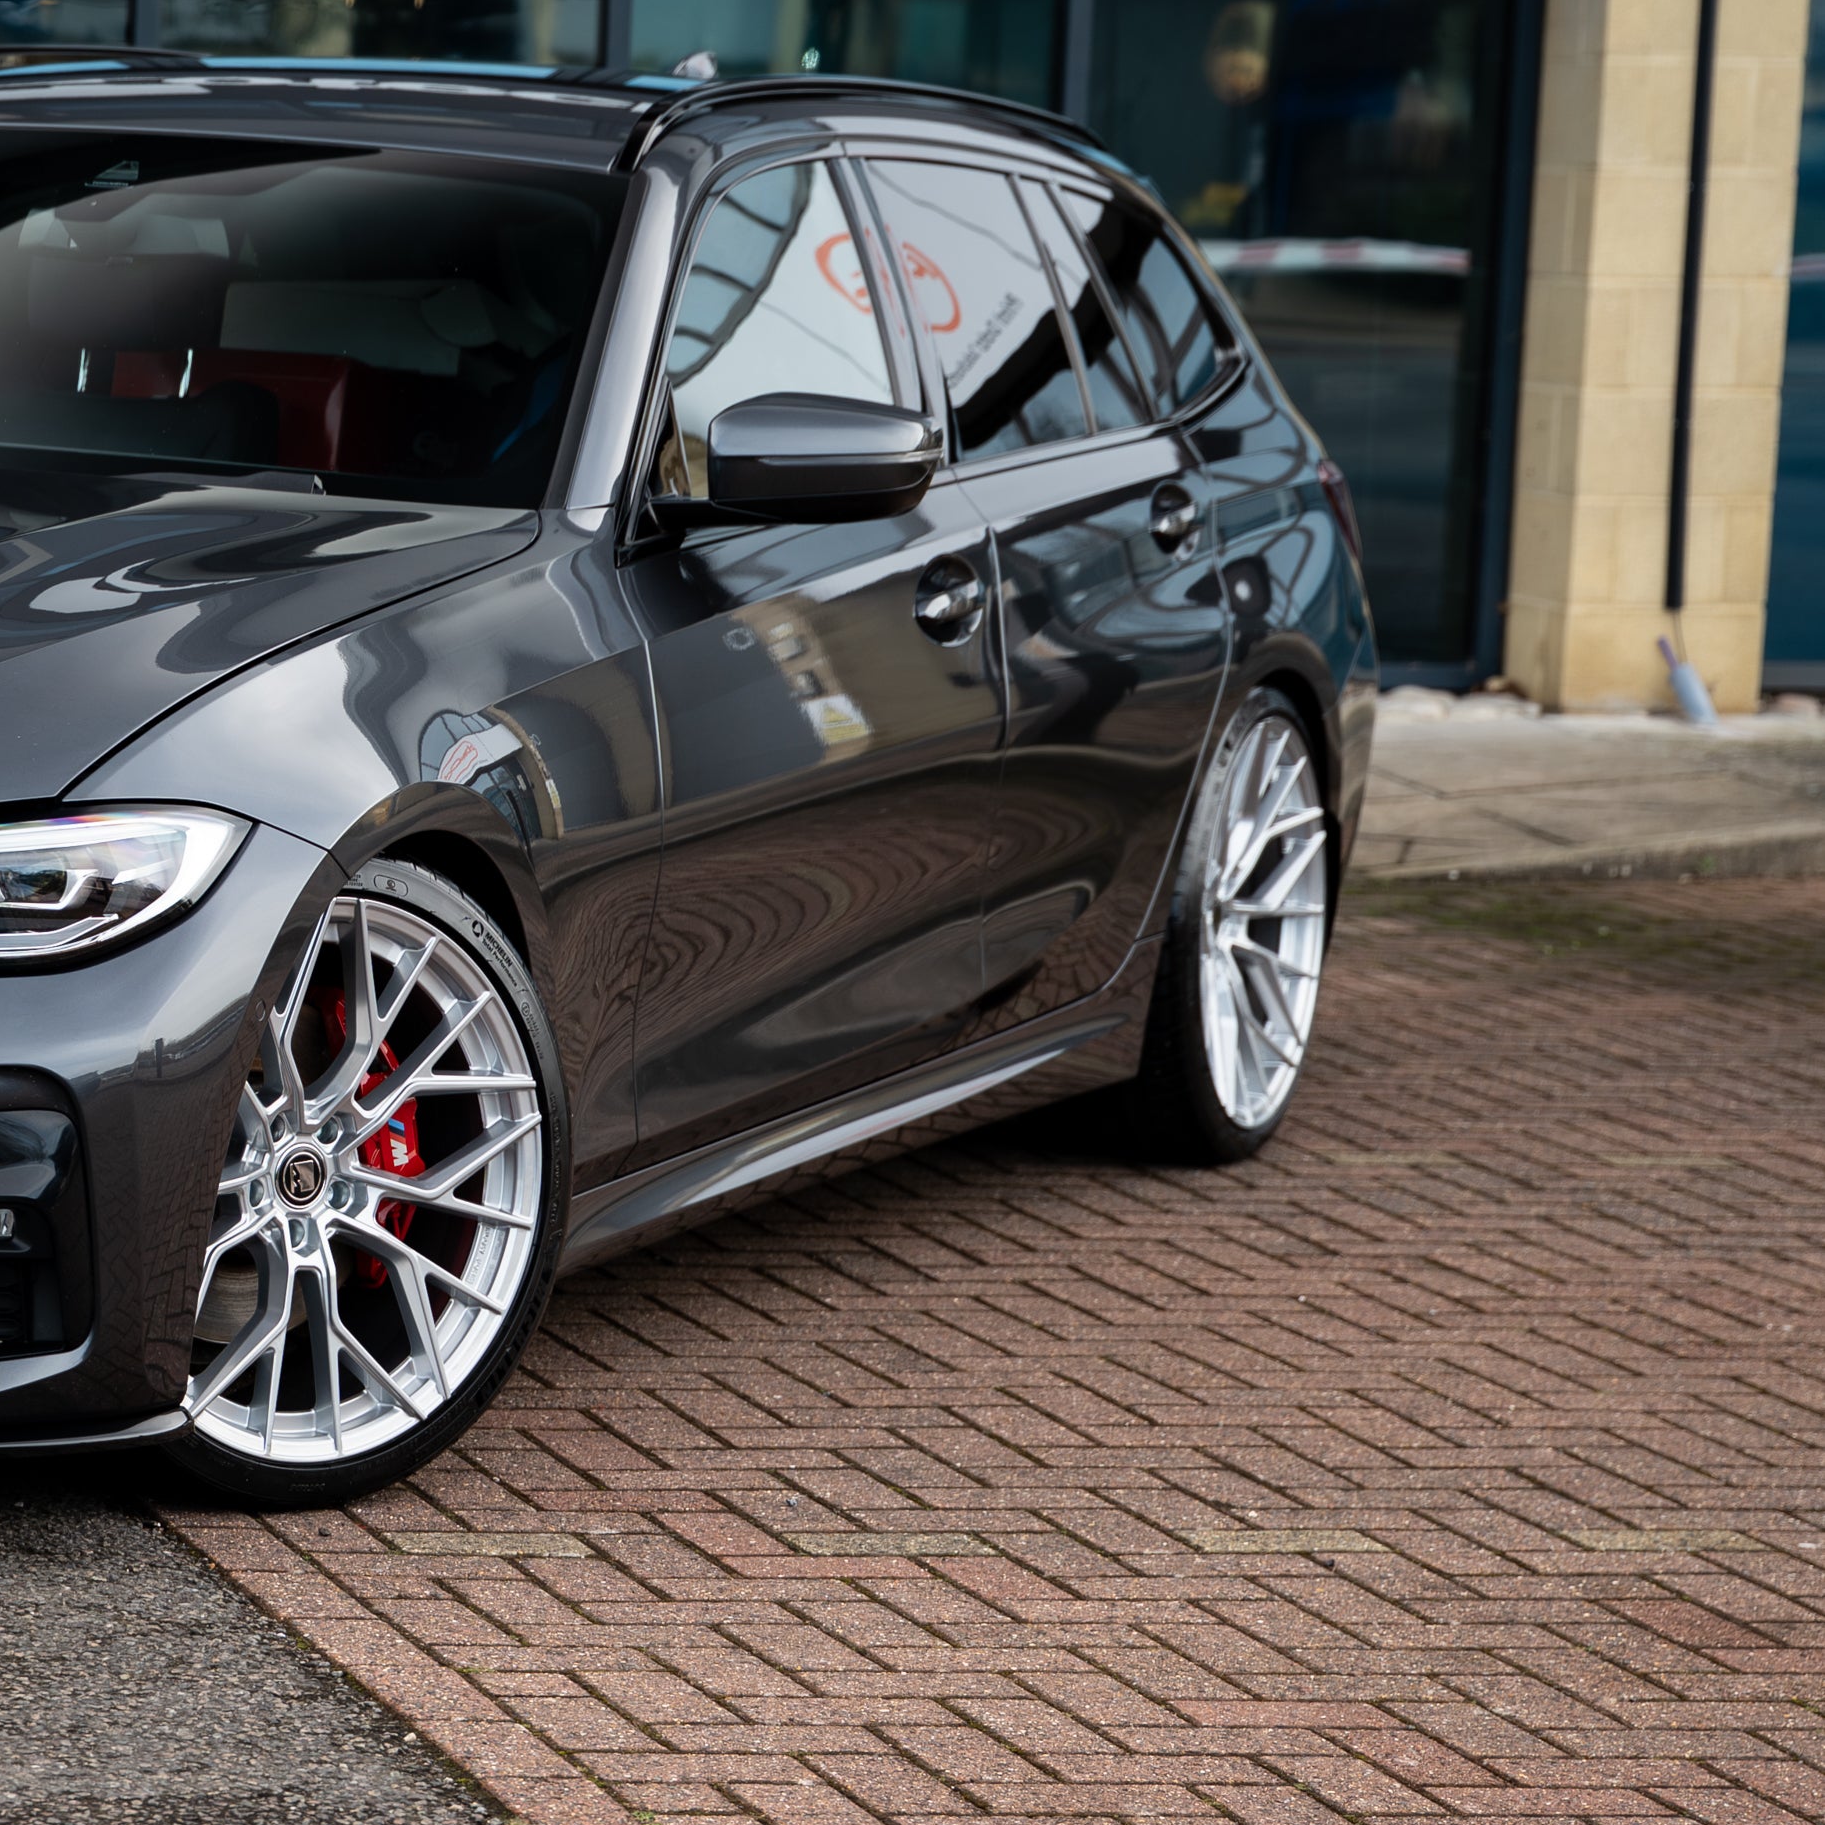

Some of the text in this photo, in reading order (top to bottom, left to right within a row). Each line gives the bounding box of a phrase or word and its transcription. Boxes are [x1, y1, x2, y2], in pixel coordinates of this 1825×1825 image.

[481, 938, 517, 987] Total Performance
[485, 932, 513, 967] MICHELIN
